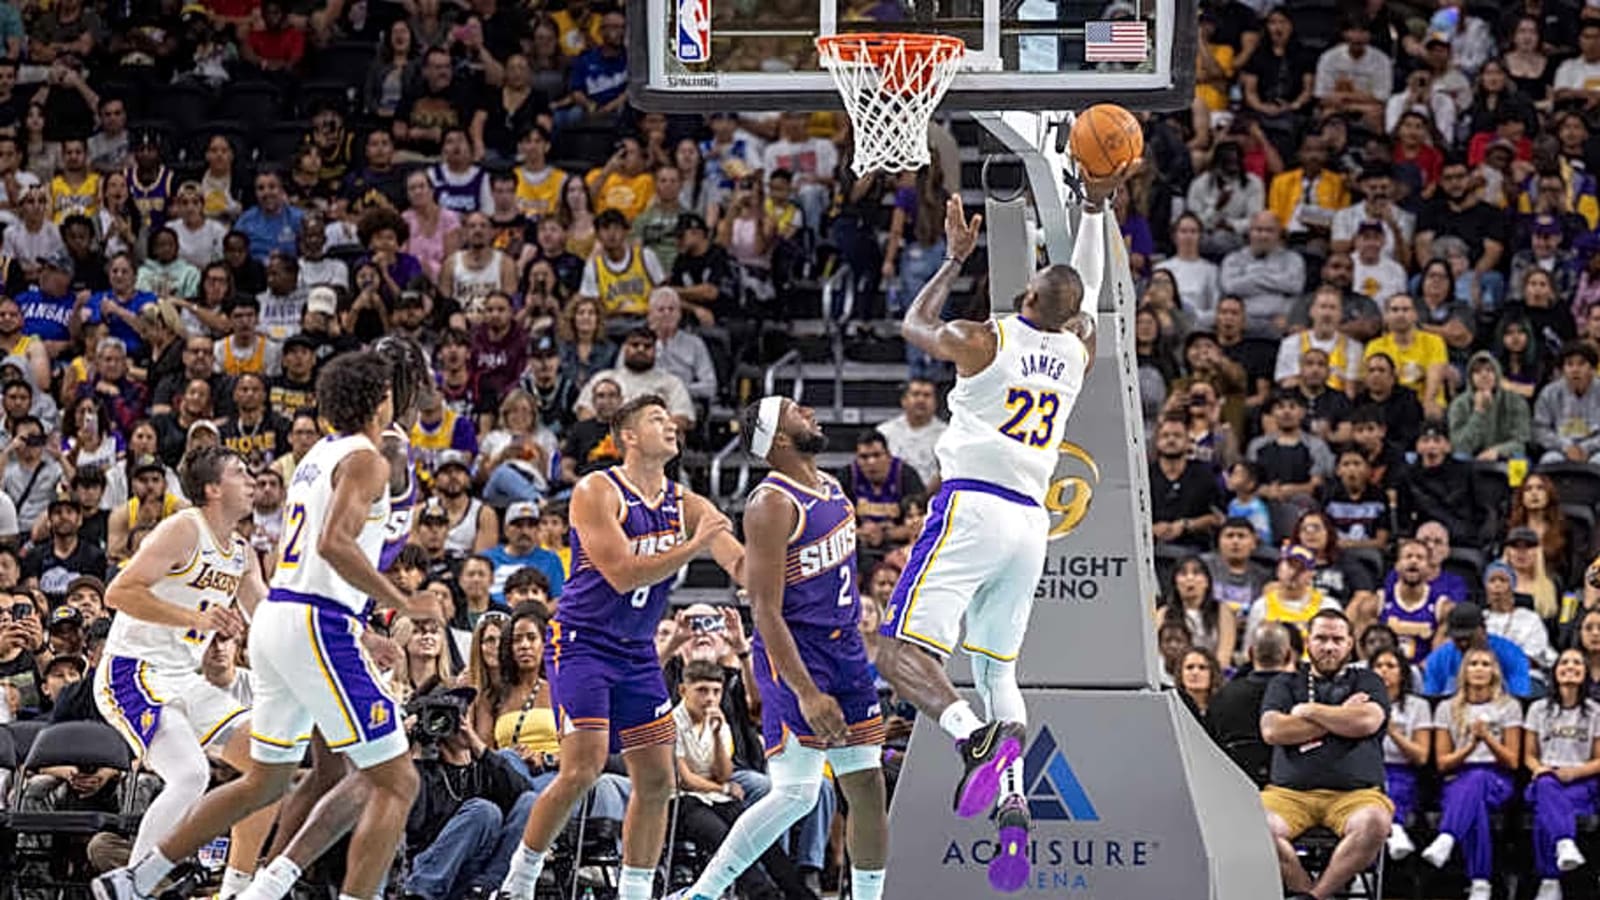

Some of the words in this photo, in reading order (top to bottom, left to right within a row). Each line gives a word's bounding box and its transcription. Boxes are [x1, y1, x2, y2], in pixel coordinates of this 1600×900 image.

[667, 77, 719, 89] SPALDING
[1020, 353, 1065, 381] JAMES
[998, 387, 1060, 450] 23
[799, 530, 856, 577] SUNS
[1043, 556, 1128, 577] LIGHT
[837, 565, 853, 606] 2
[1035, 579, 1099, 600] SINO
[941, 839, 1148, 866] ACISURE
[1027, 871, 1087, 889] ENA
